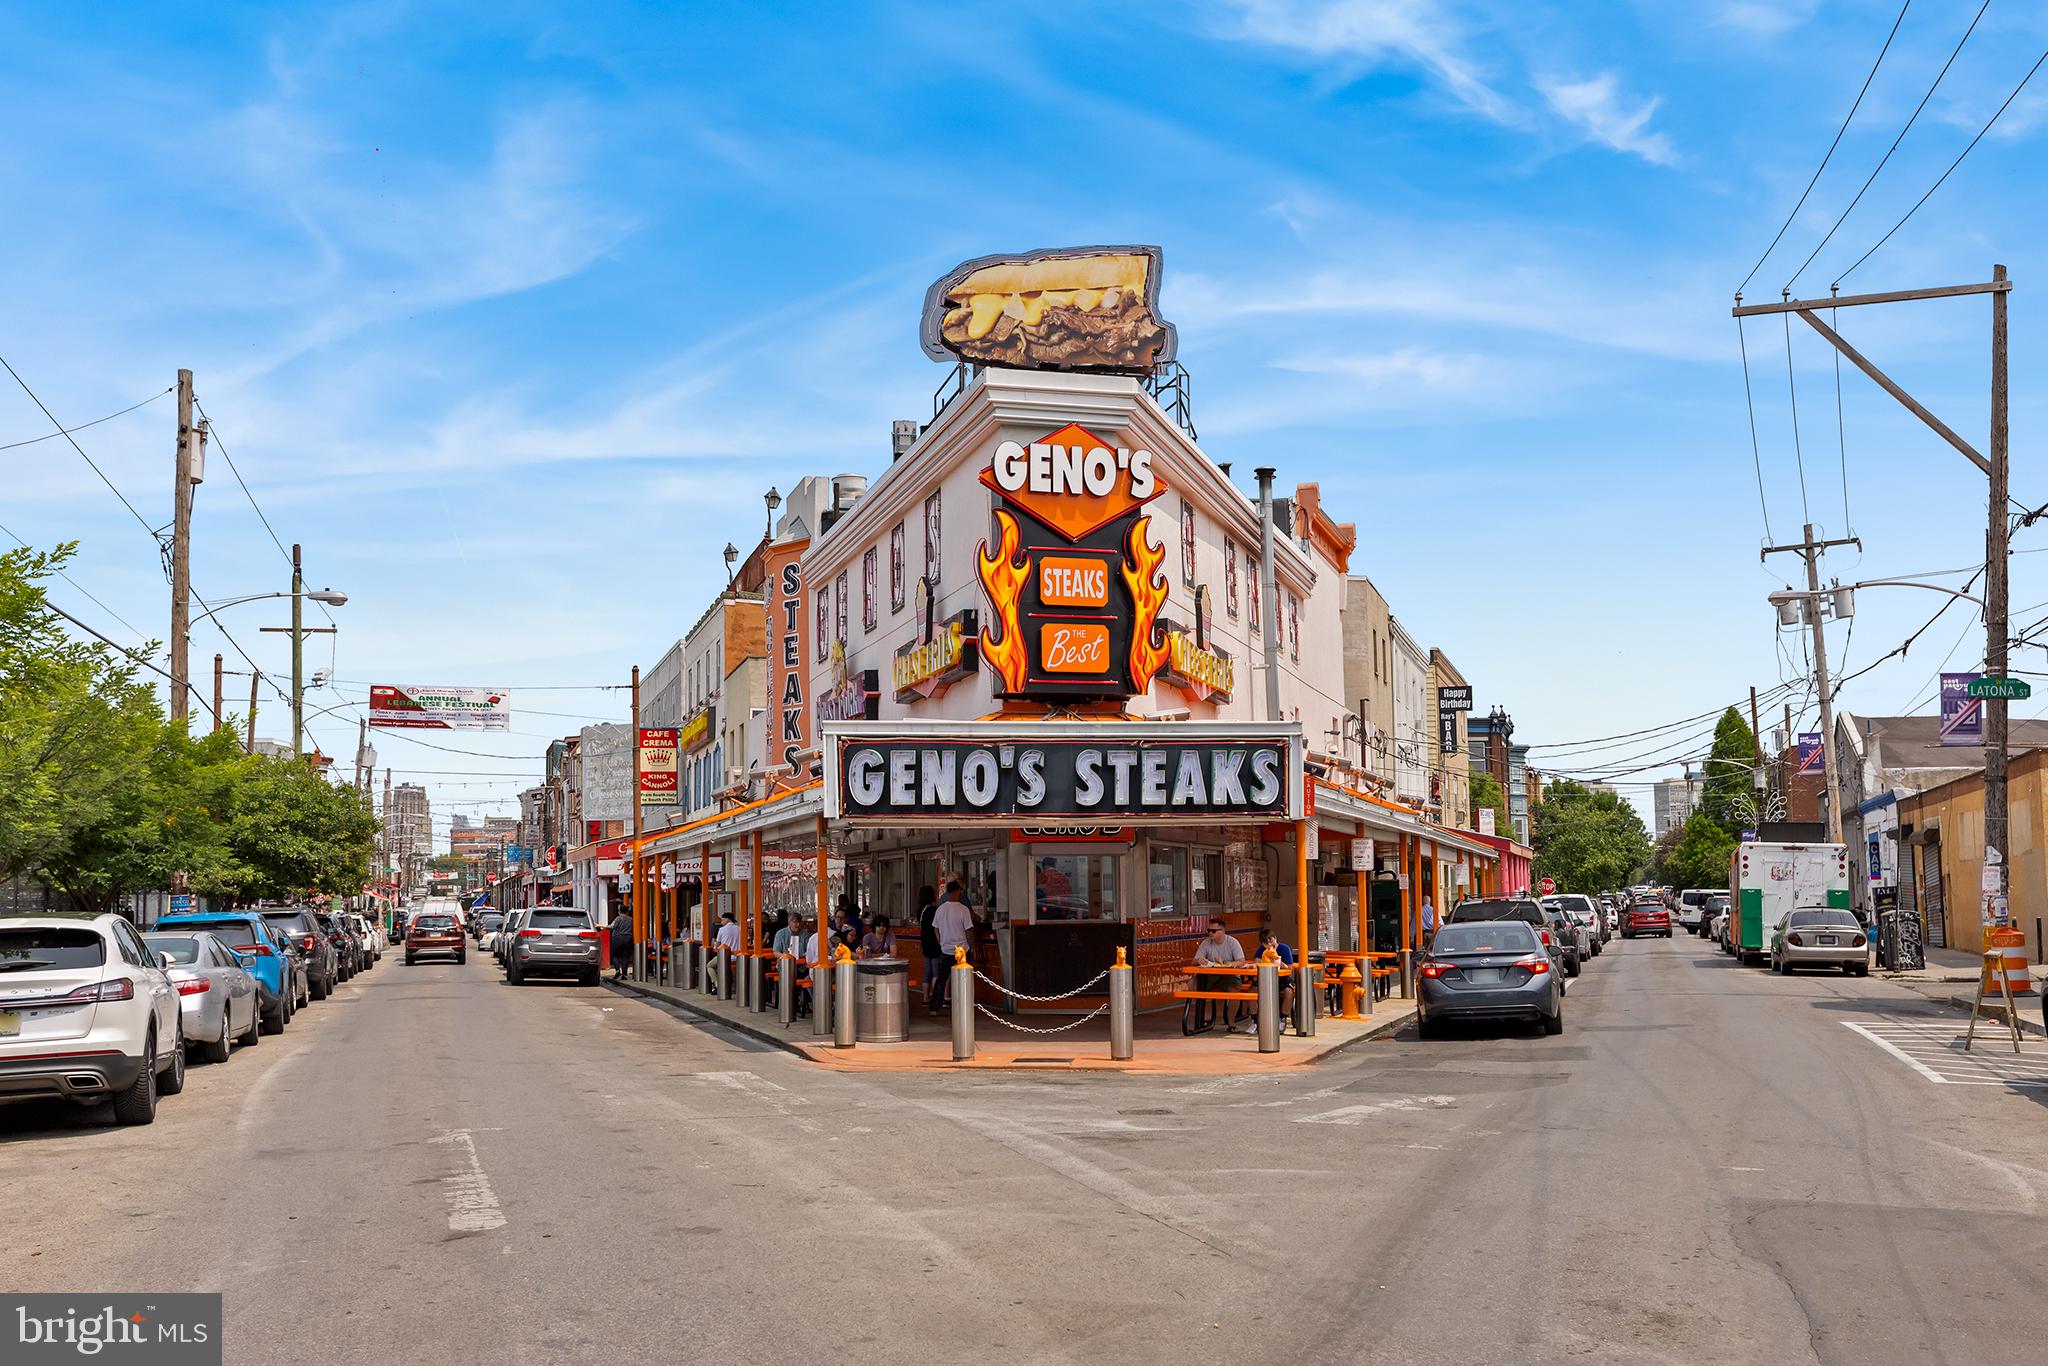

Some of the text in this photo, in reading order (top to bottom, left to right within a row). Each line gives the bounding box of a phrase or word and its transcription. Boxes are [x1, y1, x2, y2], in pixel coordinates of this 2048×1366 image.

[993, 440, 1155, 499] GENO'S
[1043, 567, 1105, 599] STEAKS
[1072, 629, 1087, 638] THE
[1046, 629, 1104, 668] Best
[781, 561, 803, 780] STEAKS
[1443, 688, 1467, 698] Happy
[1970, 685, 2029, 697] LATONA ST
[386, 699, 442, 708] LEBANESE
[418, 695, 463, 703] ANNUAL
[1440, 699, 1471, 709] Birthday
[646, 730, 669, 738] CAFE
[642, 739, 674, 747] CREMA
[848, 745, 1280, 807] GENO'S STEAKS
[641, 777, 676, 789] CANNOLI
[547, 852, 556, 860] ST
[1870, 844, 1880, 874] CAR
